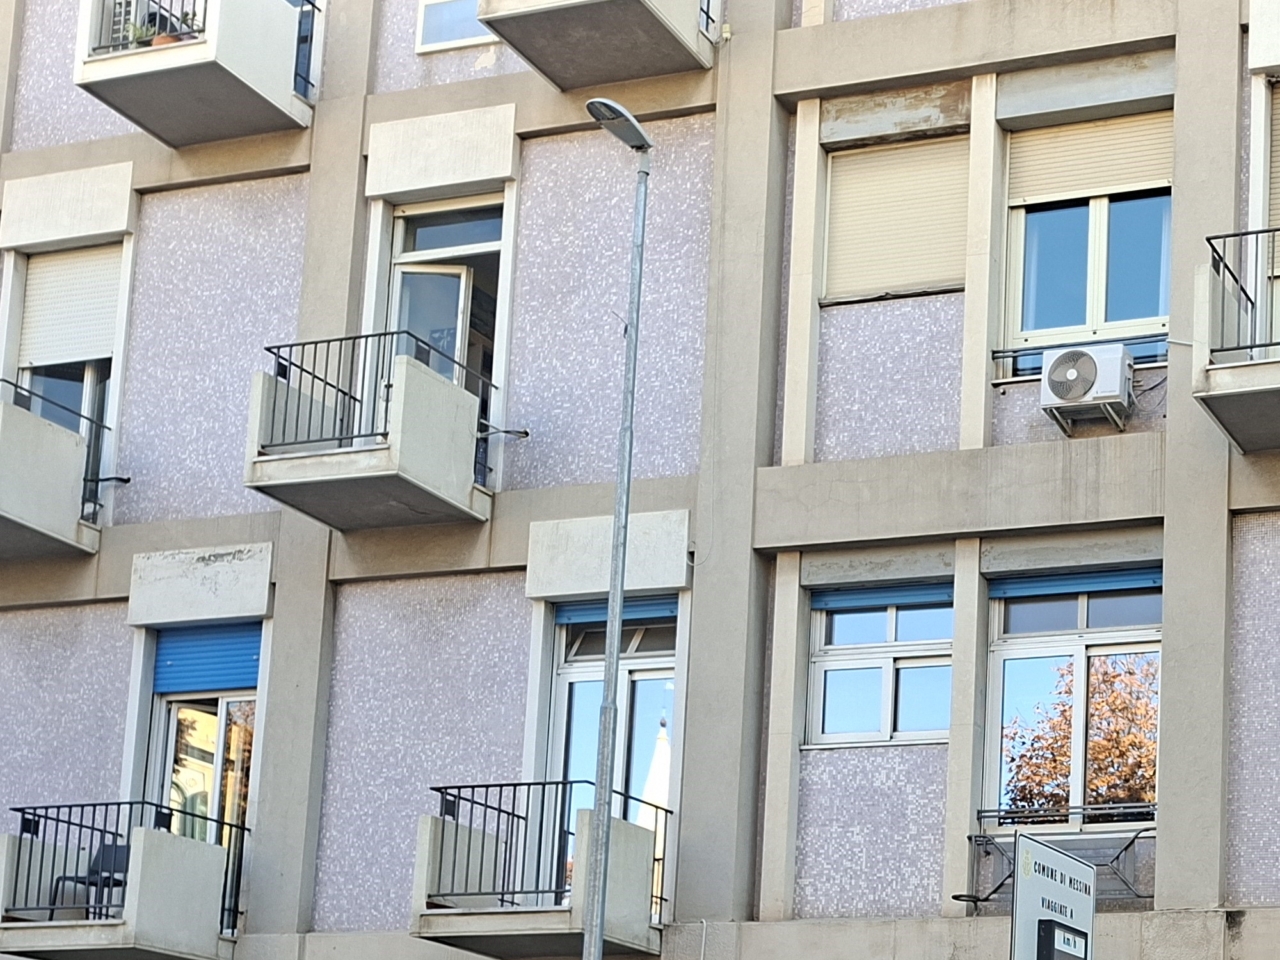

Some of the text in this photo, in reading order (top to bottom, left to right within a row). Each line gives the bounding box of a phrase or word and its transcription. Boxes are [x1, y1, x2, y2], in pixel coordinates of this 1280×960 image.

[1033, 861, 1091, 897] COMUNE DI MESSINA
[1041, 897, 1074, 920] VIAGGIATE A
[1063, 932, 1077, 949] km/h
